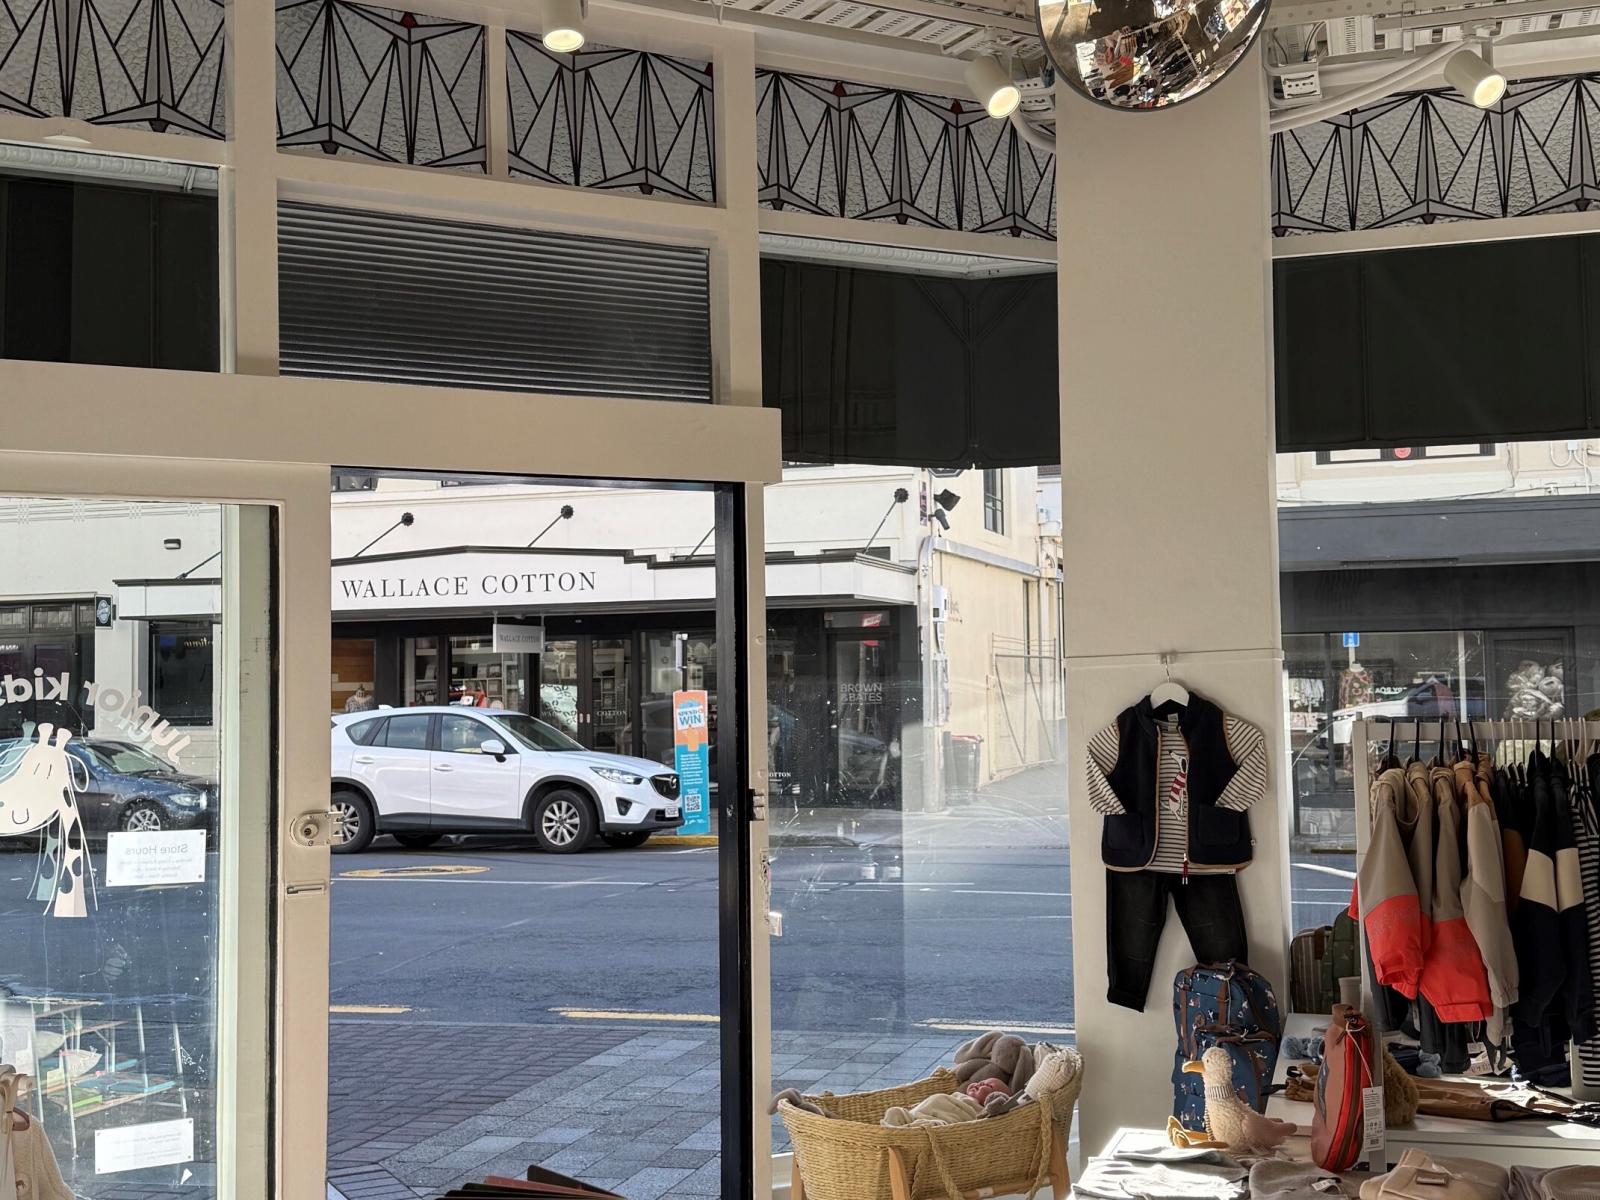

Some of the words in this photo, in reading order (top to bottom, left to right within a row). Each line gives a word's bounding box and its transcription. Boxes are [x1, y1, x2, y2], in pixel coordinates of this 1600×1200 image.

[340, 576, 468, 598] WALLACE
[481, 571, 596, 595] COTTON
[840, 683, 882, 692] BROWN
[679, 714, 701, 726] WIN
